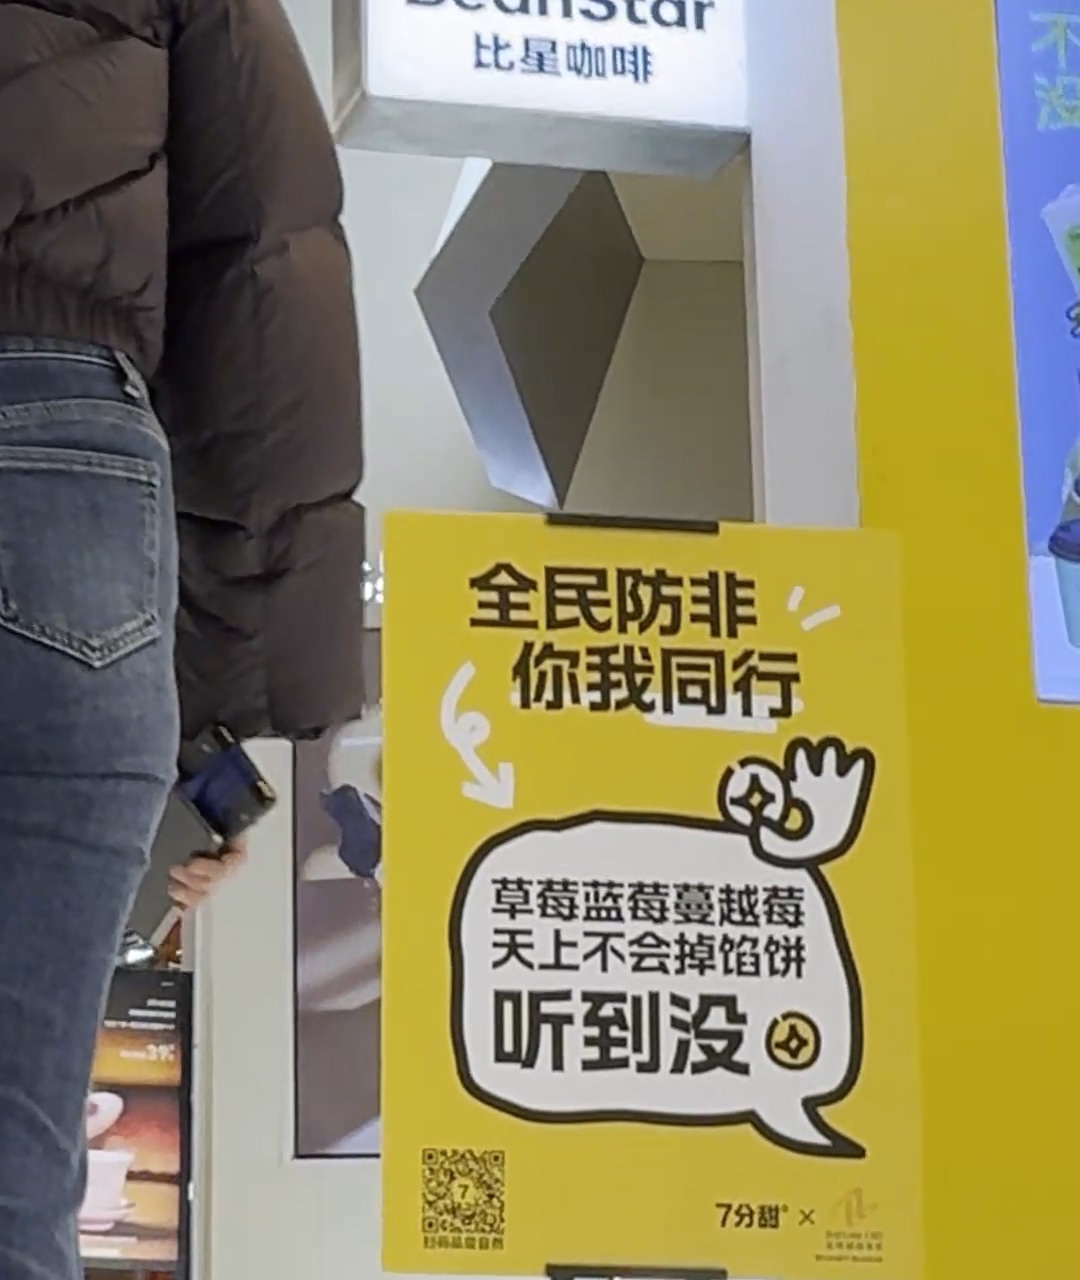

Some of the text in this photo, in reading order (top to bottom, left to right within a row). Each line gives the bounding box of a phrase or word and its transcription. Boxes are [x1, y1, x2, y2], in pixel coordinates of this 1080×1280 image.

[474, 33, 654, 84] 比星咖啡
[468, 561, 758, 639] 全民防非
[512, 640, 801, 719] 你我同行
[490, 877, 806, 929] 草莓蓝莓蔓越莓
[491, 927, 807, 980] 天上不会掉馅饼
[493, 988, 751, 1077] 听到没
